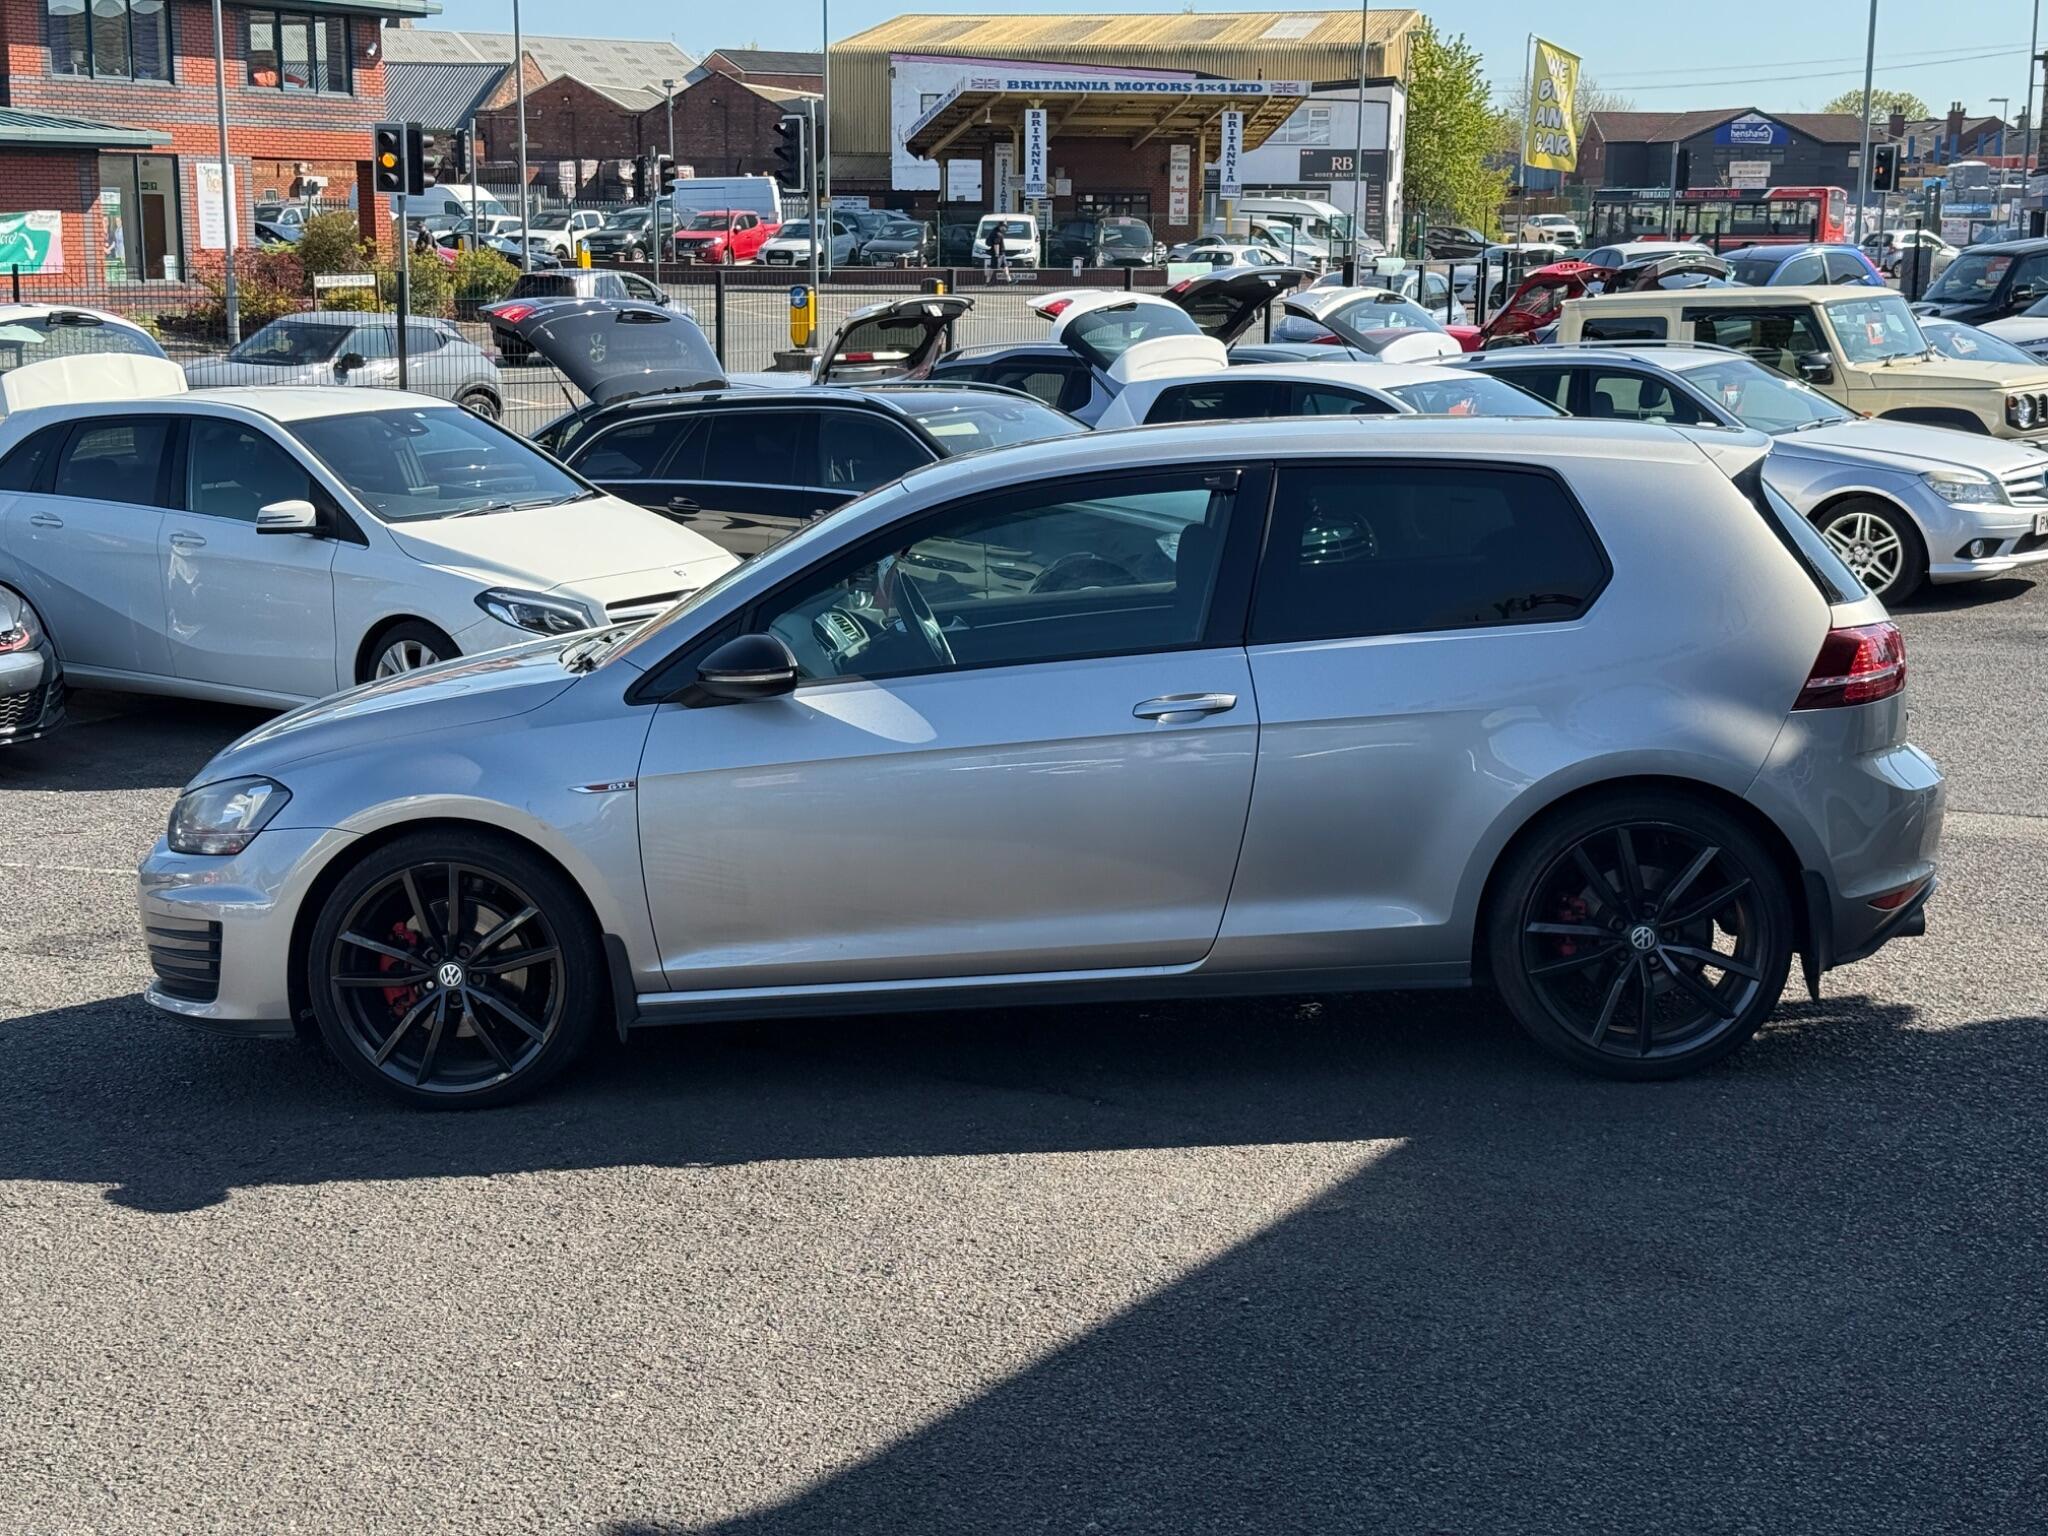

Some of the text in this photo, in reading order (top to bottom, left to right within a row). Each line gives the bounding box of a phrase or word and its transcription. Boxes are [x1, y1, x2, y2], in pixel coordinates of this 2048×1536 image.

[1007, 80, 1264, 94] BRITANNIA MOTORS 4x4 LTD
[1031, 111, 1041, 181] BRITANNIA
[1226, 113, 1237, 182] BRITANNIA
[1533, 132, 1570, 158] CAR
[1331, 156, 1353, 171] RB
